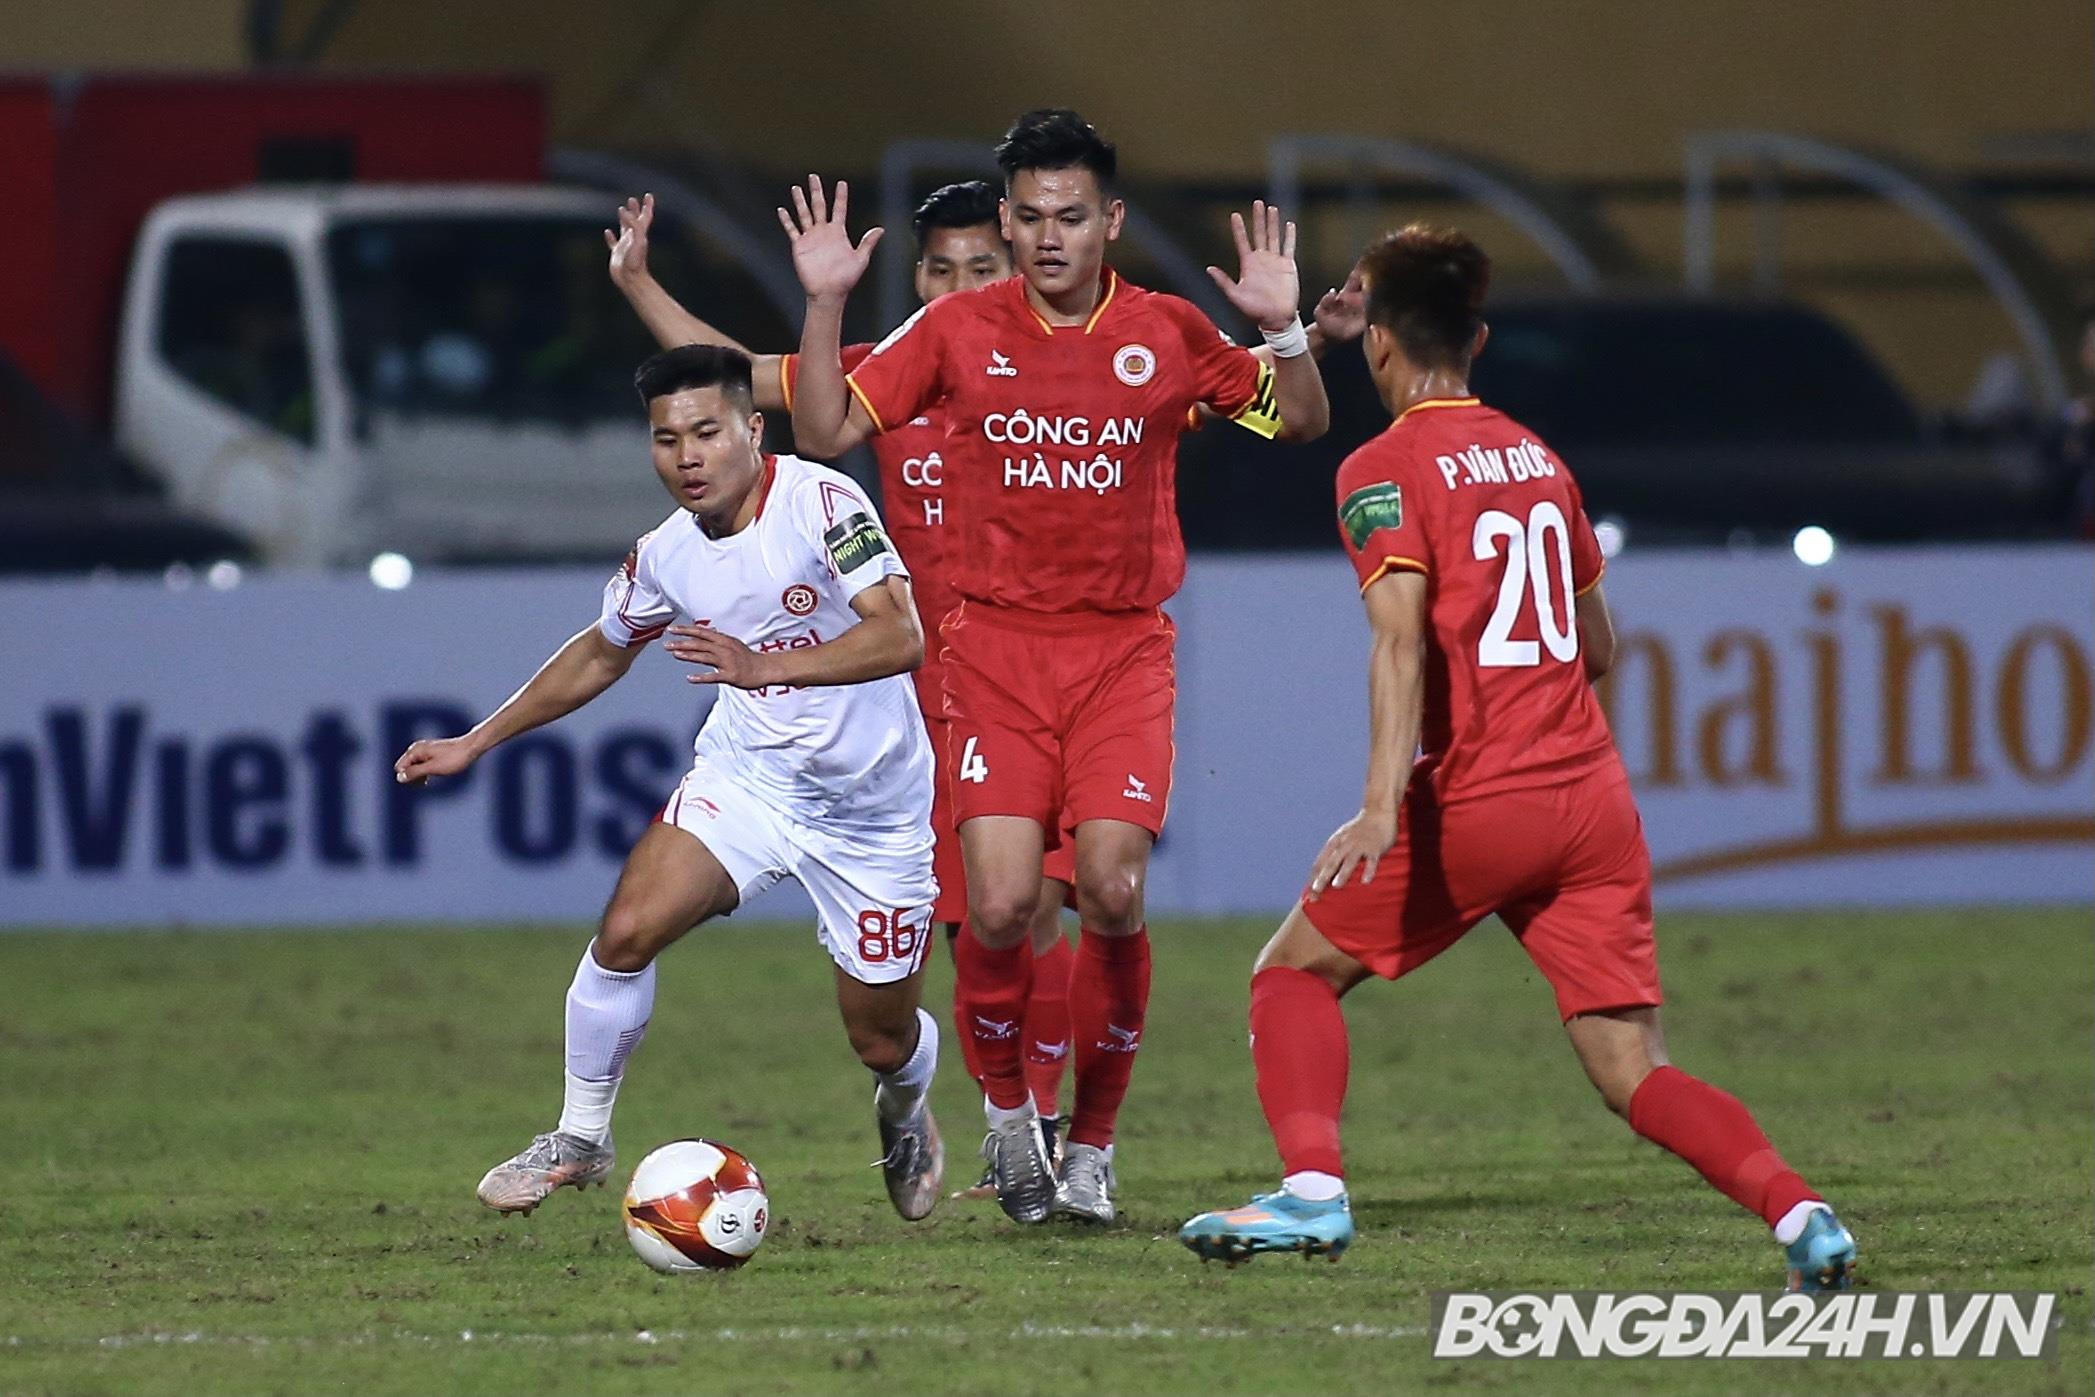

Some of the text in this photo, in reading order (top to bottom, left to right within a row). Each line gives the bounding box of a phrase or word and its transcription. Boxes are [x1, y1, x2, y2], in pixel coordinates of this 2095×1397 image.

[983, 408, 1144, 445] CÔNG AN
[1003, 453, 1121, 495] HÀ NỘI
[923, 498, 943, 525] H
[833, 534, 864, 563] NIGHT
[1472, 501, 1578, 666] 20
[960, 736, 988, 783] 4
[858, 908, 916, 962] 86
